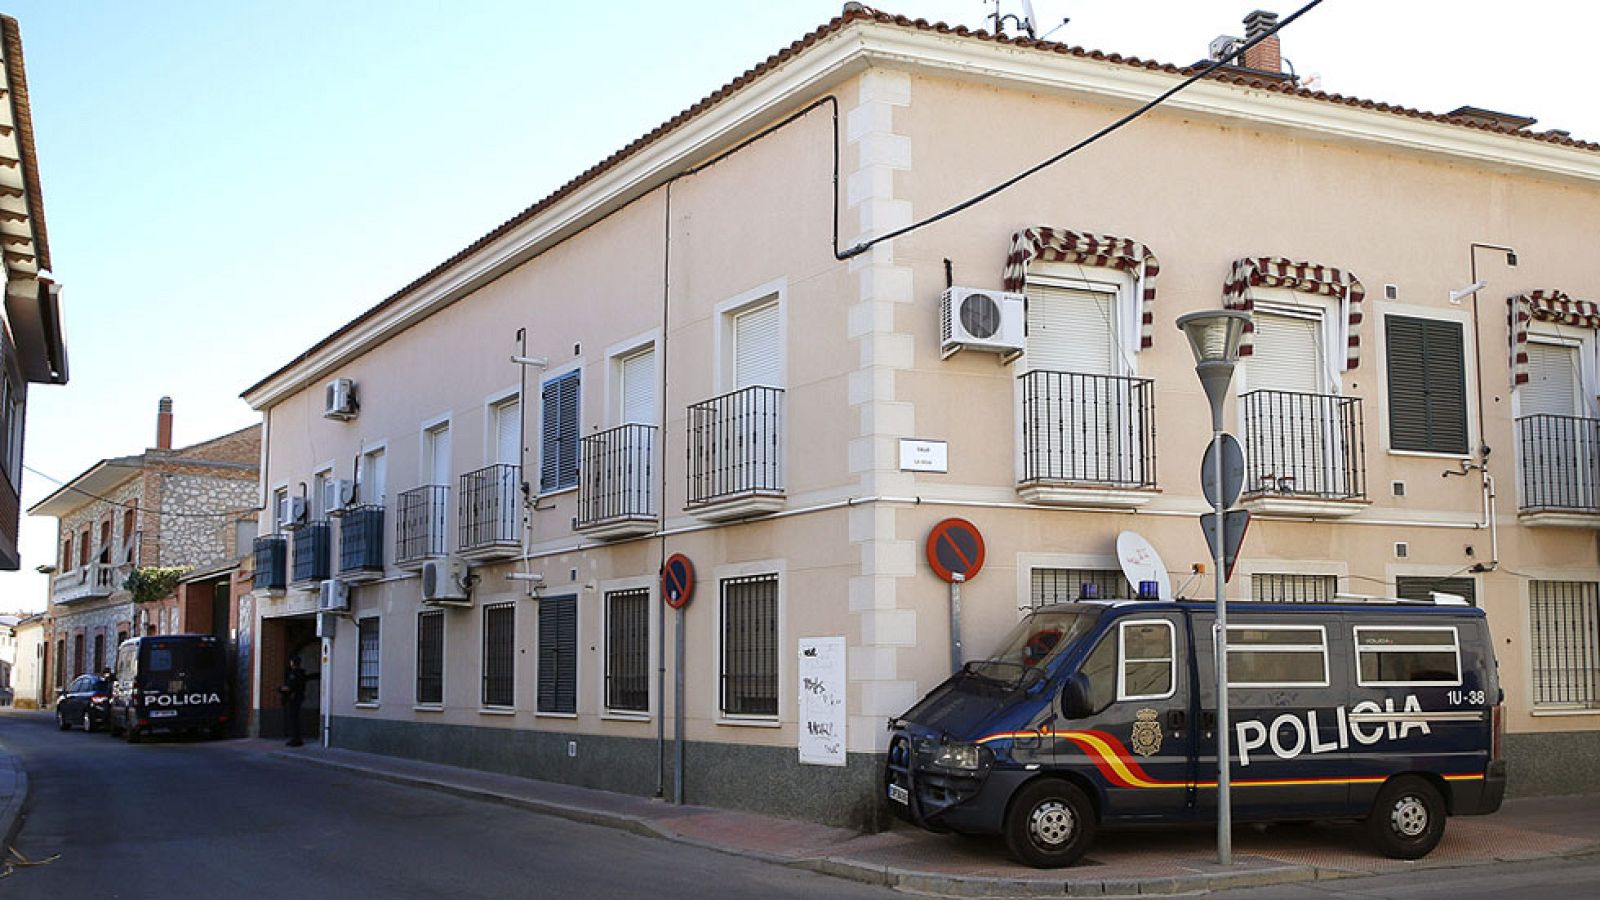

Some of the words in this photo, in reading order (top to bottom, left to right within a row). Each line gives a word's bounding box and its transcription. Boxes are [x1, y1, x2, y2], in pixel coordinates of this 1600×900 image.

[144, 693, 221, 706] POLICIA
[1446, 690, 1485, 705] 1U-38
[1236, 695, 1431, 767] POLICIA
